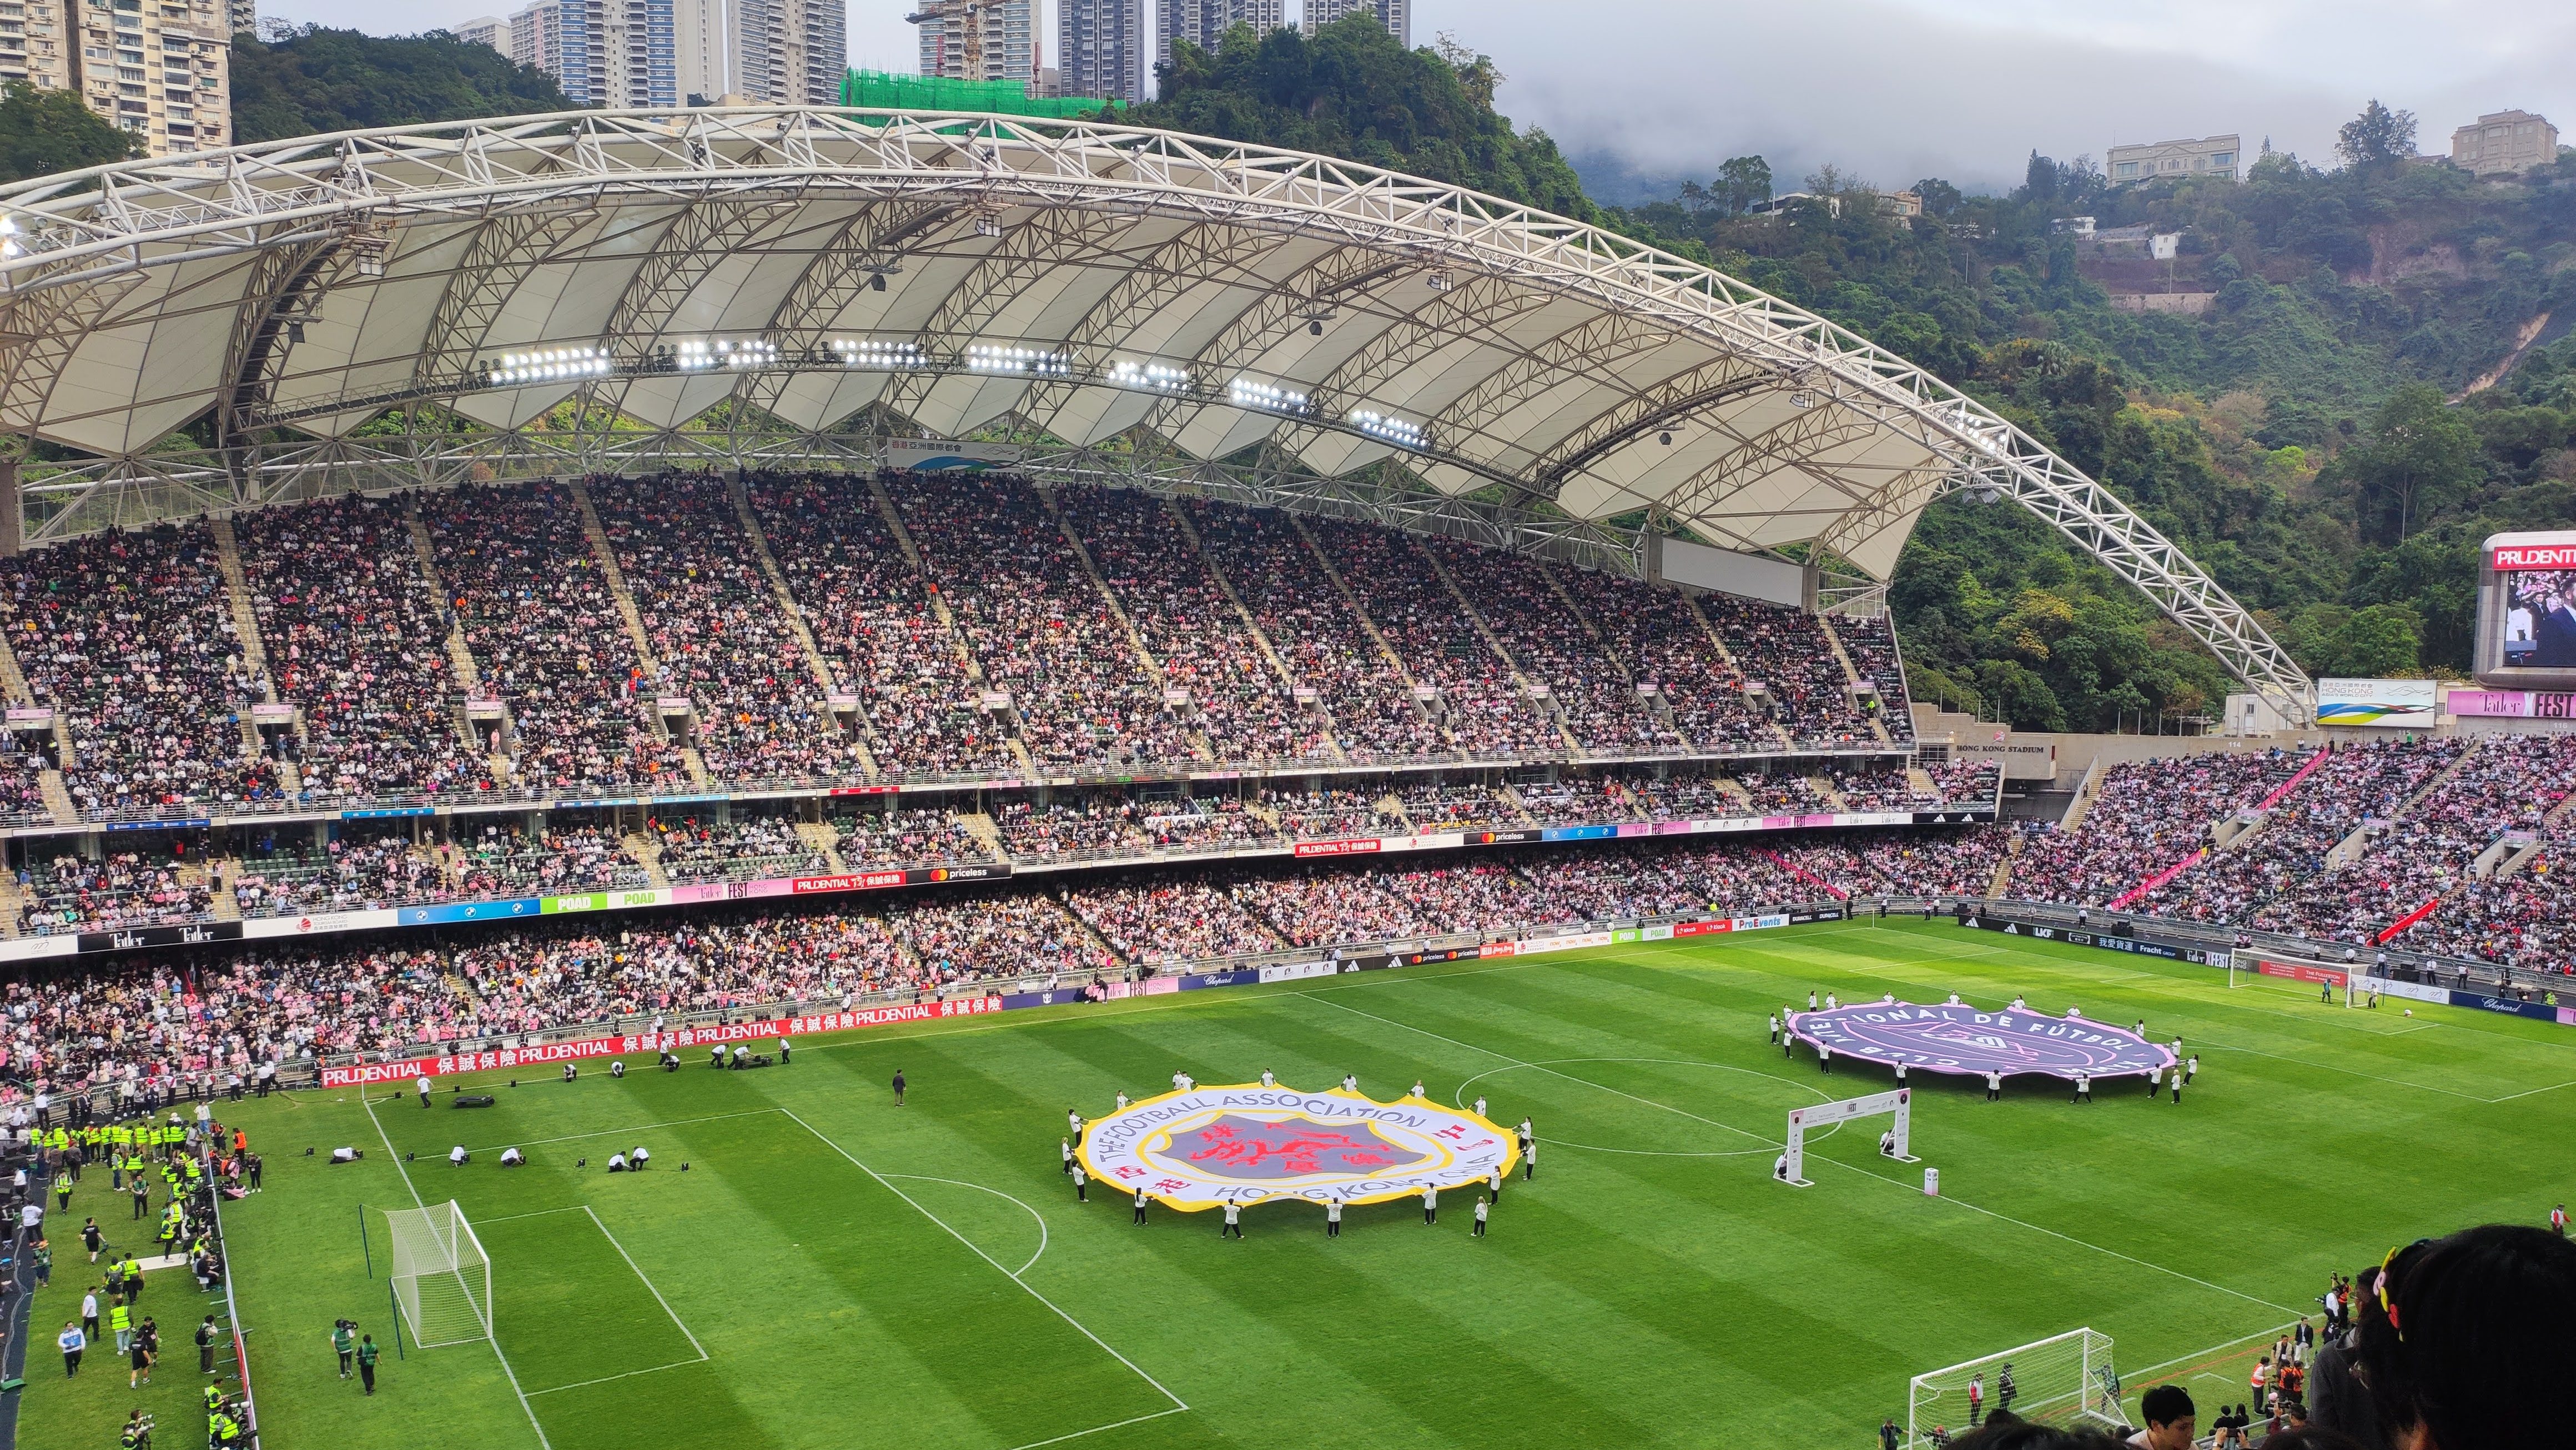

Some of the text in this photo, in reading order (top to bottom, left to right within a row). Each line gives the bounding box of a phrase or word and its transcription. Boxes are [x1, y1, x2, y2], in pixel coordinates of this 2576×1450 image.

[892, 440, 962, 452] 香港亞洲國際都會
[2479, 694, 2520, 713] Tatler
[1496, 832, 1524, 842] priceless
[1299, 844, 1339, 854] PRUDENTIAL
[950, 868, 987, 879] priceless
[798, 879, 851, 890] PRUDENTIAL
[557, 897, 591, 911] POAD
[624, 892, 656, 905] POAD
[1739, 917, 1781, 929] ProEvents
[109, 930, 145, 948] Tatler
[179, 925, 214, 942] Tatler
[1619, 932, 1635, 941] POAD
[1651, 929, 1666, 937] POAD
[2035, 927, 2052, 938] LKF
[2099, 937, 2134, 951] 我愛貨運
[2140, 945, 2162, 955] Fracht
[1458, 948, 1480, 957] priceless
[2185, 949, 2205, 962] Tatler
[1204, 974, 1235, 986] Chopard
[940, 996, 1002, 1017] 保誠保險
[2481, 997, 2522, 1012] Chopard
[856, 1005, 932, 1025] PRUDENTIAL
[789, 1012, 854, 1034] 保誠保險
[697, 1022, 781, 1042] PRUDENTIAL
[1974, 1014, 2013, 1027] DE
[2028, 1023, 2134, 1050] FÚTBOL
[622, 1030, 695, 1052] 保誠保險
[519, 1040, 612, 1064] PRUDENTIAL
[436, 1051, 517, 1075] 保誠保險
[324, 1062, 426, 1086] PRUDENTIAL
[1099, 1093, 1427, 1162] THE FOOTBALL ASSOCIATION
[1213, 1186, 1334, 1200] HOG
[1438, 1153, 1497, 1178] CHINA
